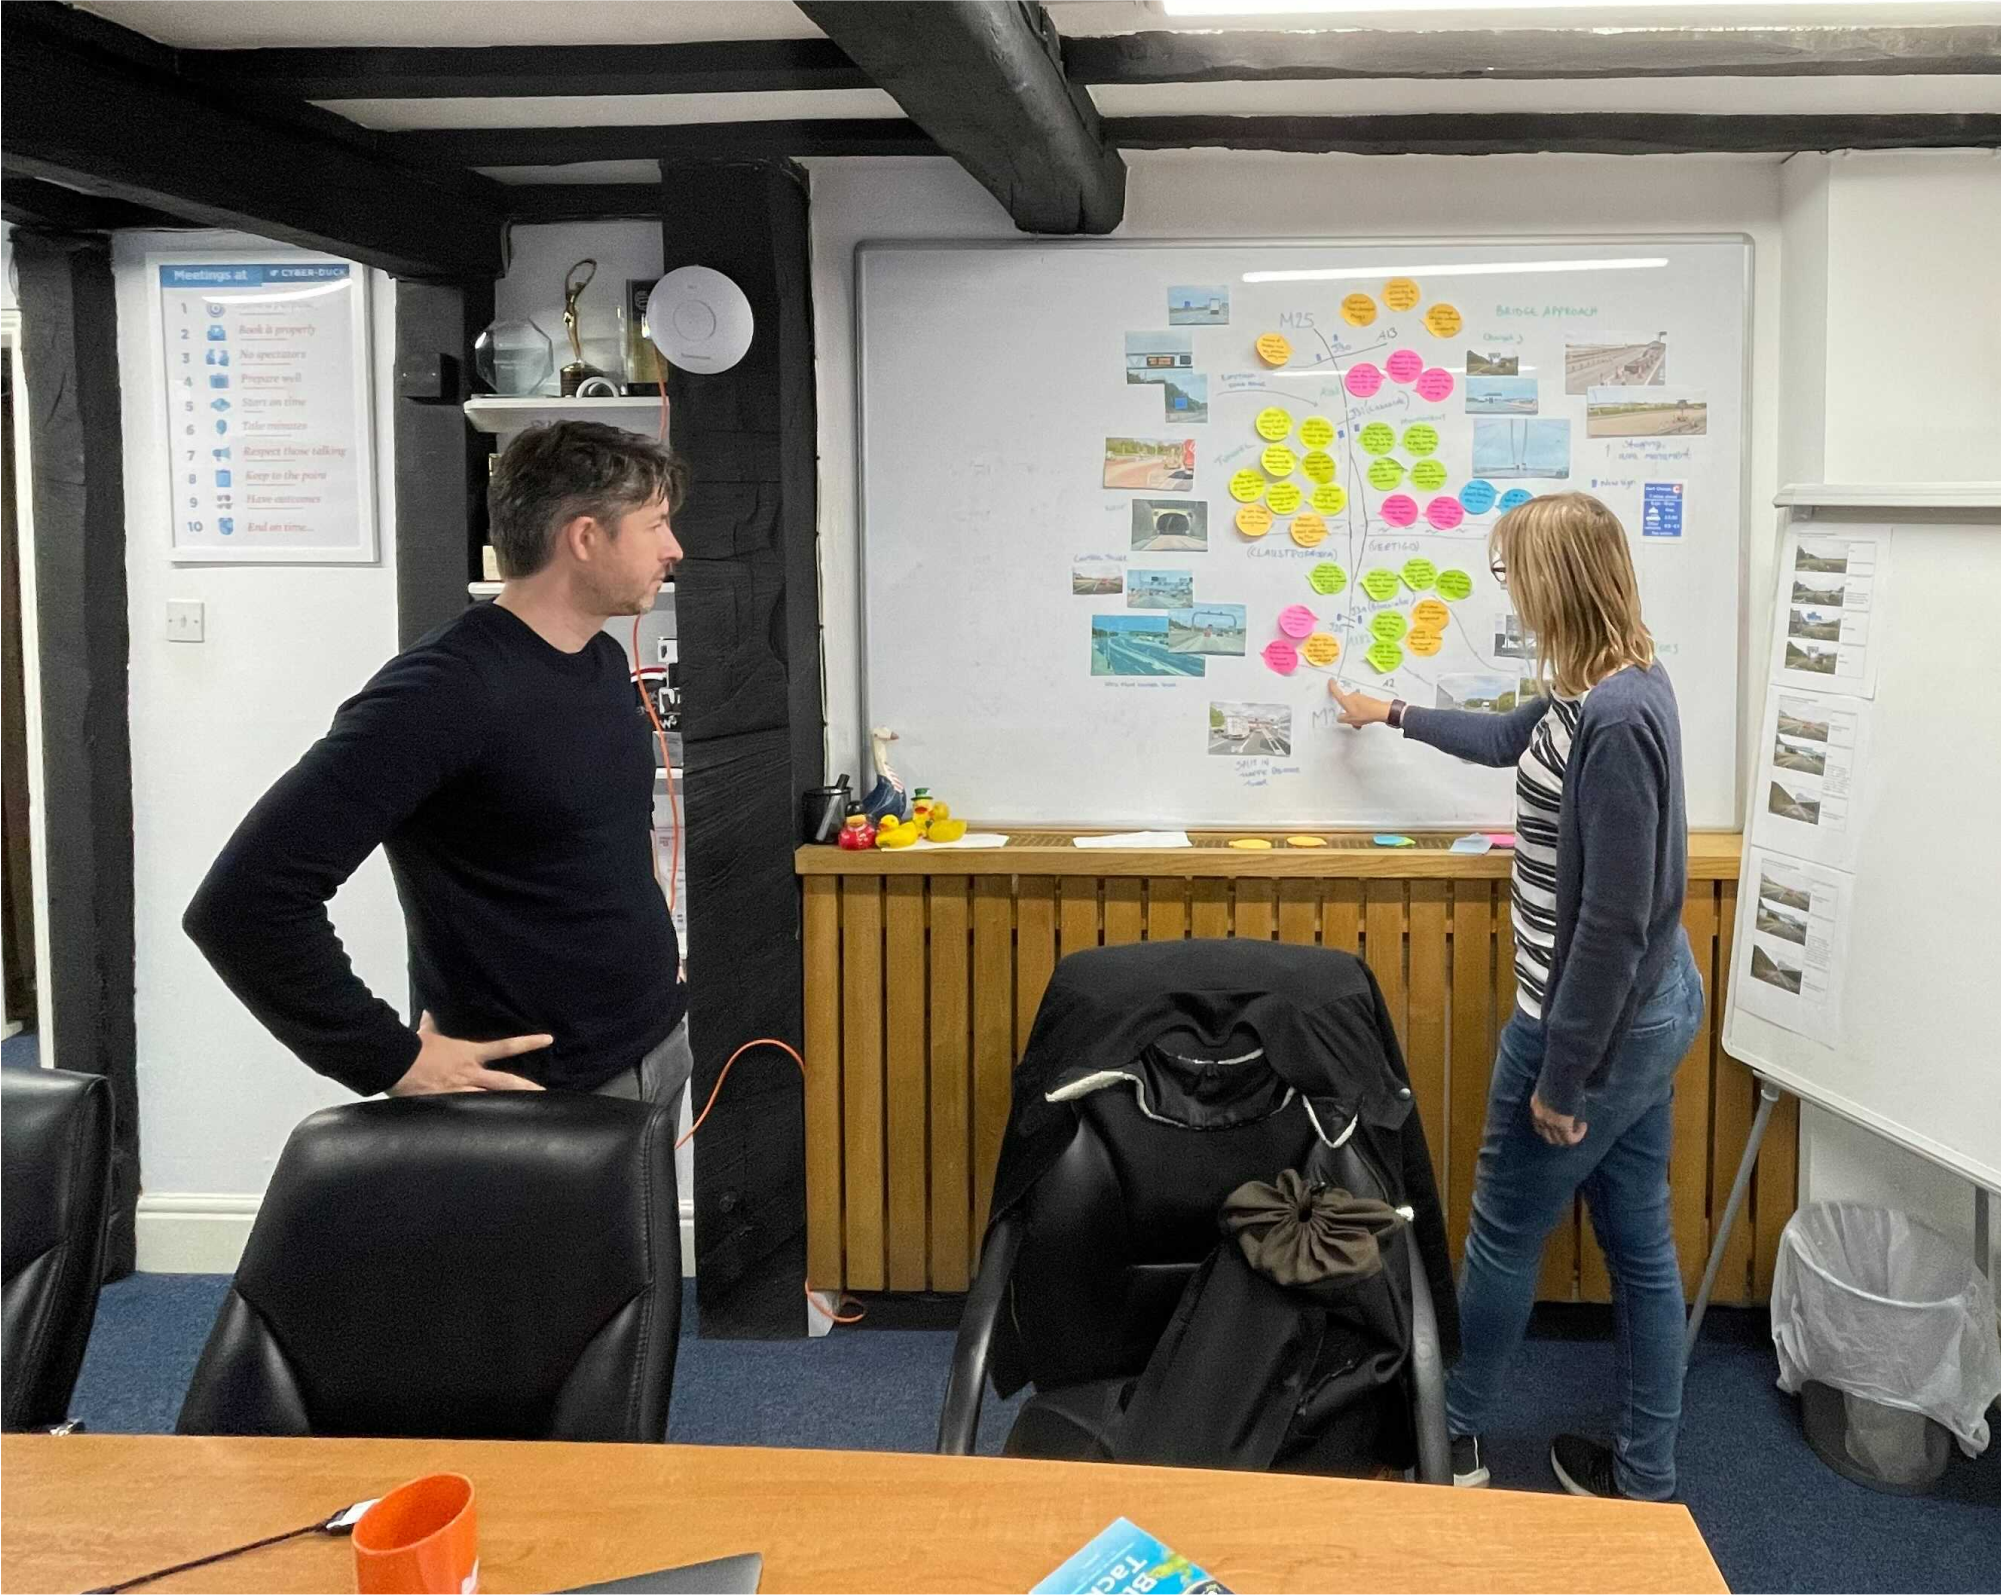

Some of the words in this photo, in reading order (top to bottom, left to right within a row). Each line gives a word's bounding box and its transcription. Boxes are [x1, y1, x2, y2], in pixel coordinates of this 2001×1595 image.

[173, 269, 231, 282] Meetings
[234, 269, 248, 281] at
[281, 268, 346, 277] CYBER-DUCK
[181, 302, 188, 314] 1
[1495, 304, 1539, 317] BRIDGE
[1542, 305, 1599, 318] APPROACH
[1279, 311, 1315, 329] M25
[180, 328, 190, 340] 2
[238, 324, 263, 334] Book
[274, 324, 316, 337] properly
[1375, 326, 1398, 342] A13
[181, 352, 191, 364] 3
[239, 349, 255, 359] No
[256, 349, 307, 361] spectators
[183, 376, 193, 387] 4
[241, 373, 279, 385] Prepare
[282, 372, 302, 383] well
[185, 401, 194, 412] 5
[241, 397, 267, 408] Start
[284, 397, 307, 407] time
[185, 424, 195, 436] 6
[242, 421, 265, 431] Take
[187, 450, 195, 461] 7
[244, 446, 281, 458] Respect
[283, 446, 310, 457] those
[311, 445, 347, 459] talking
[188, 473, 197, 485] 8
[245, 470, 269, 482] Keep
[271, 471, 283, 480] to
[284, 470, 300, 480] the
[189, 497, 198, 508] 9
[246, 494, 270, 504] Have
[187, 521, 203, 533] 10
[247, 522, 268, 532] End
[269, 524, 283, 532] on
